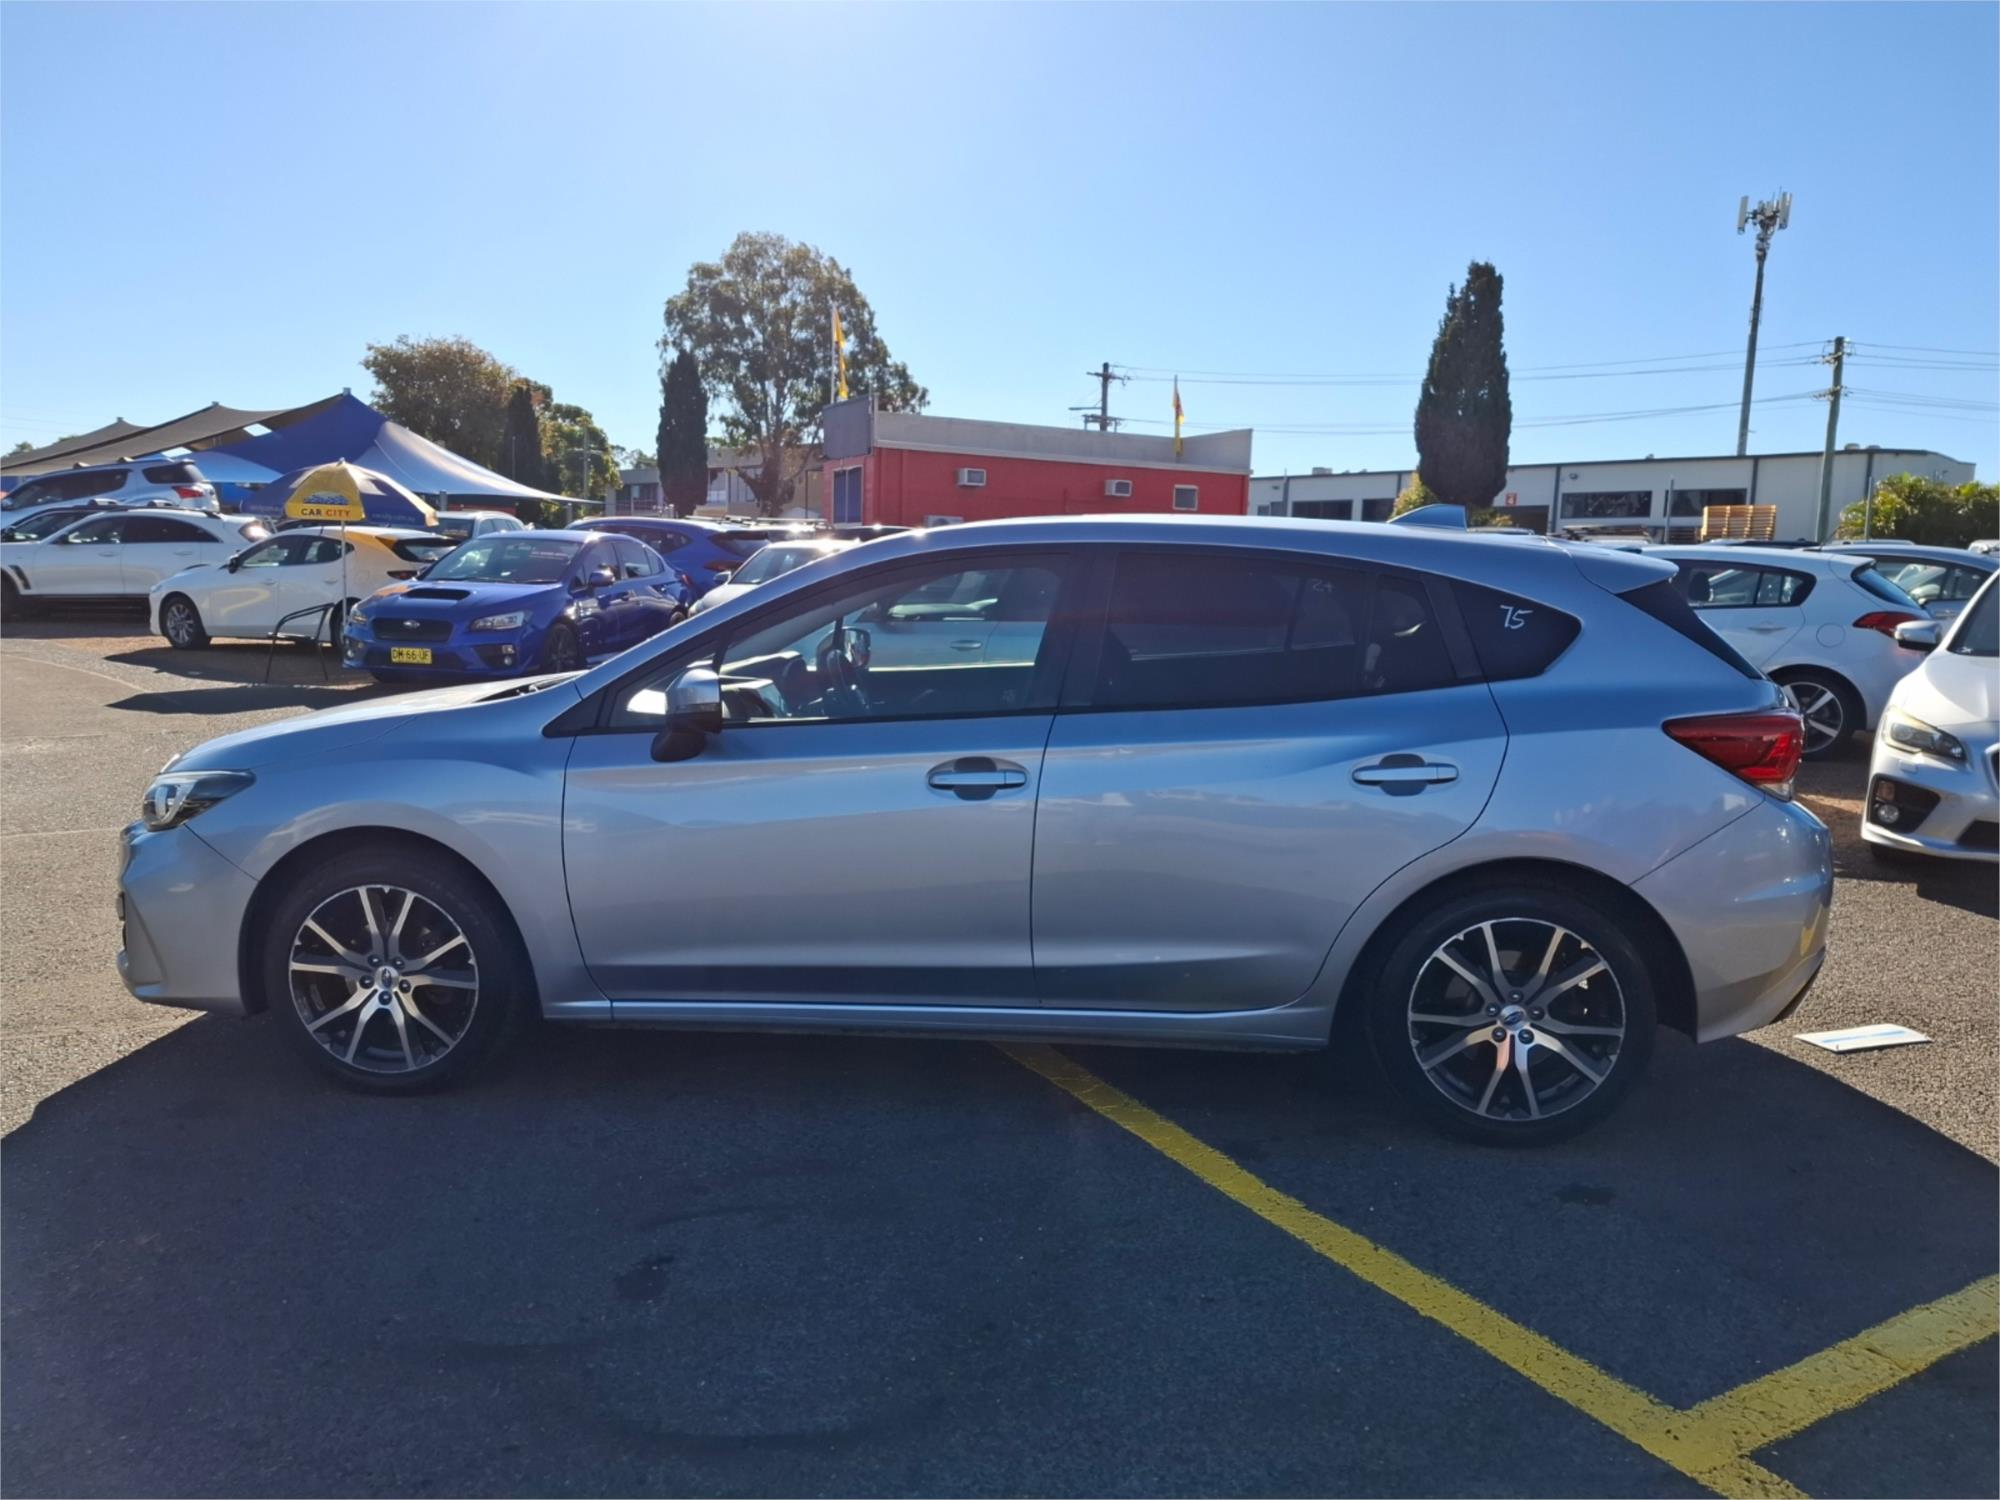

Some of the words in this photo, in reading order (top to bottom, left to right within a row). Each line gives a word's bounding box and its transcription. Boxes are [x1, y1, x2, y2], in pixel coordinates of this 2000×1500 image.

[300, 508, 321, 516] CAR
[326, 509, 351, 517] CITY
[1500, 605, 1533, 629] 75
